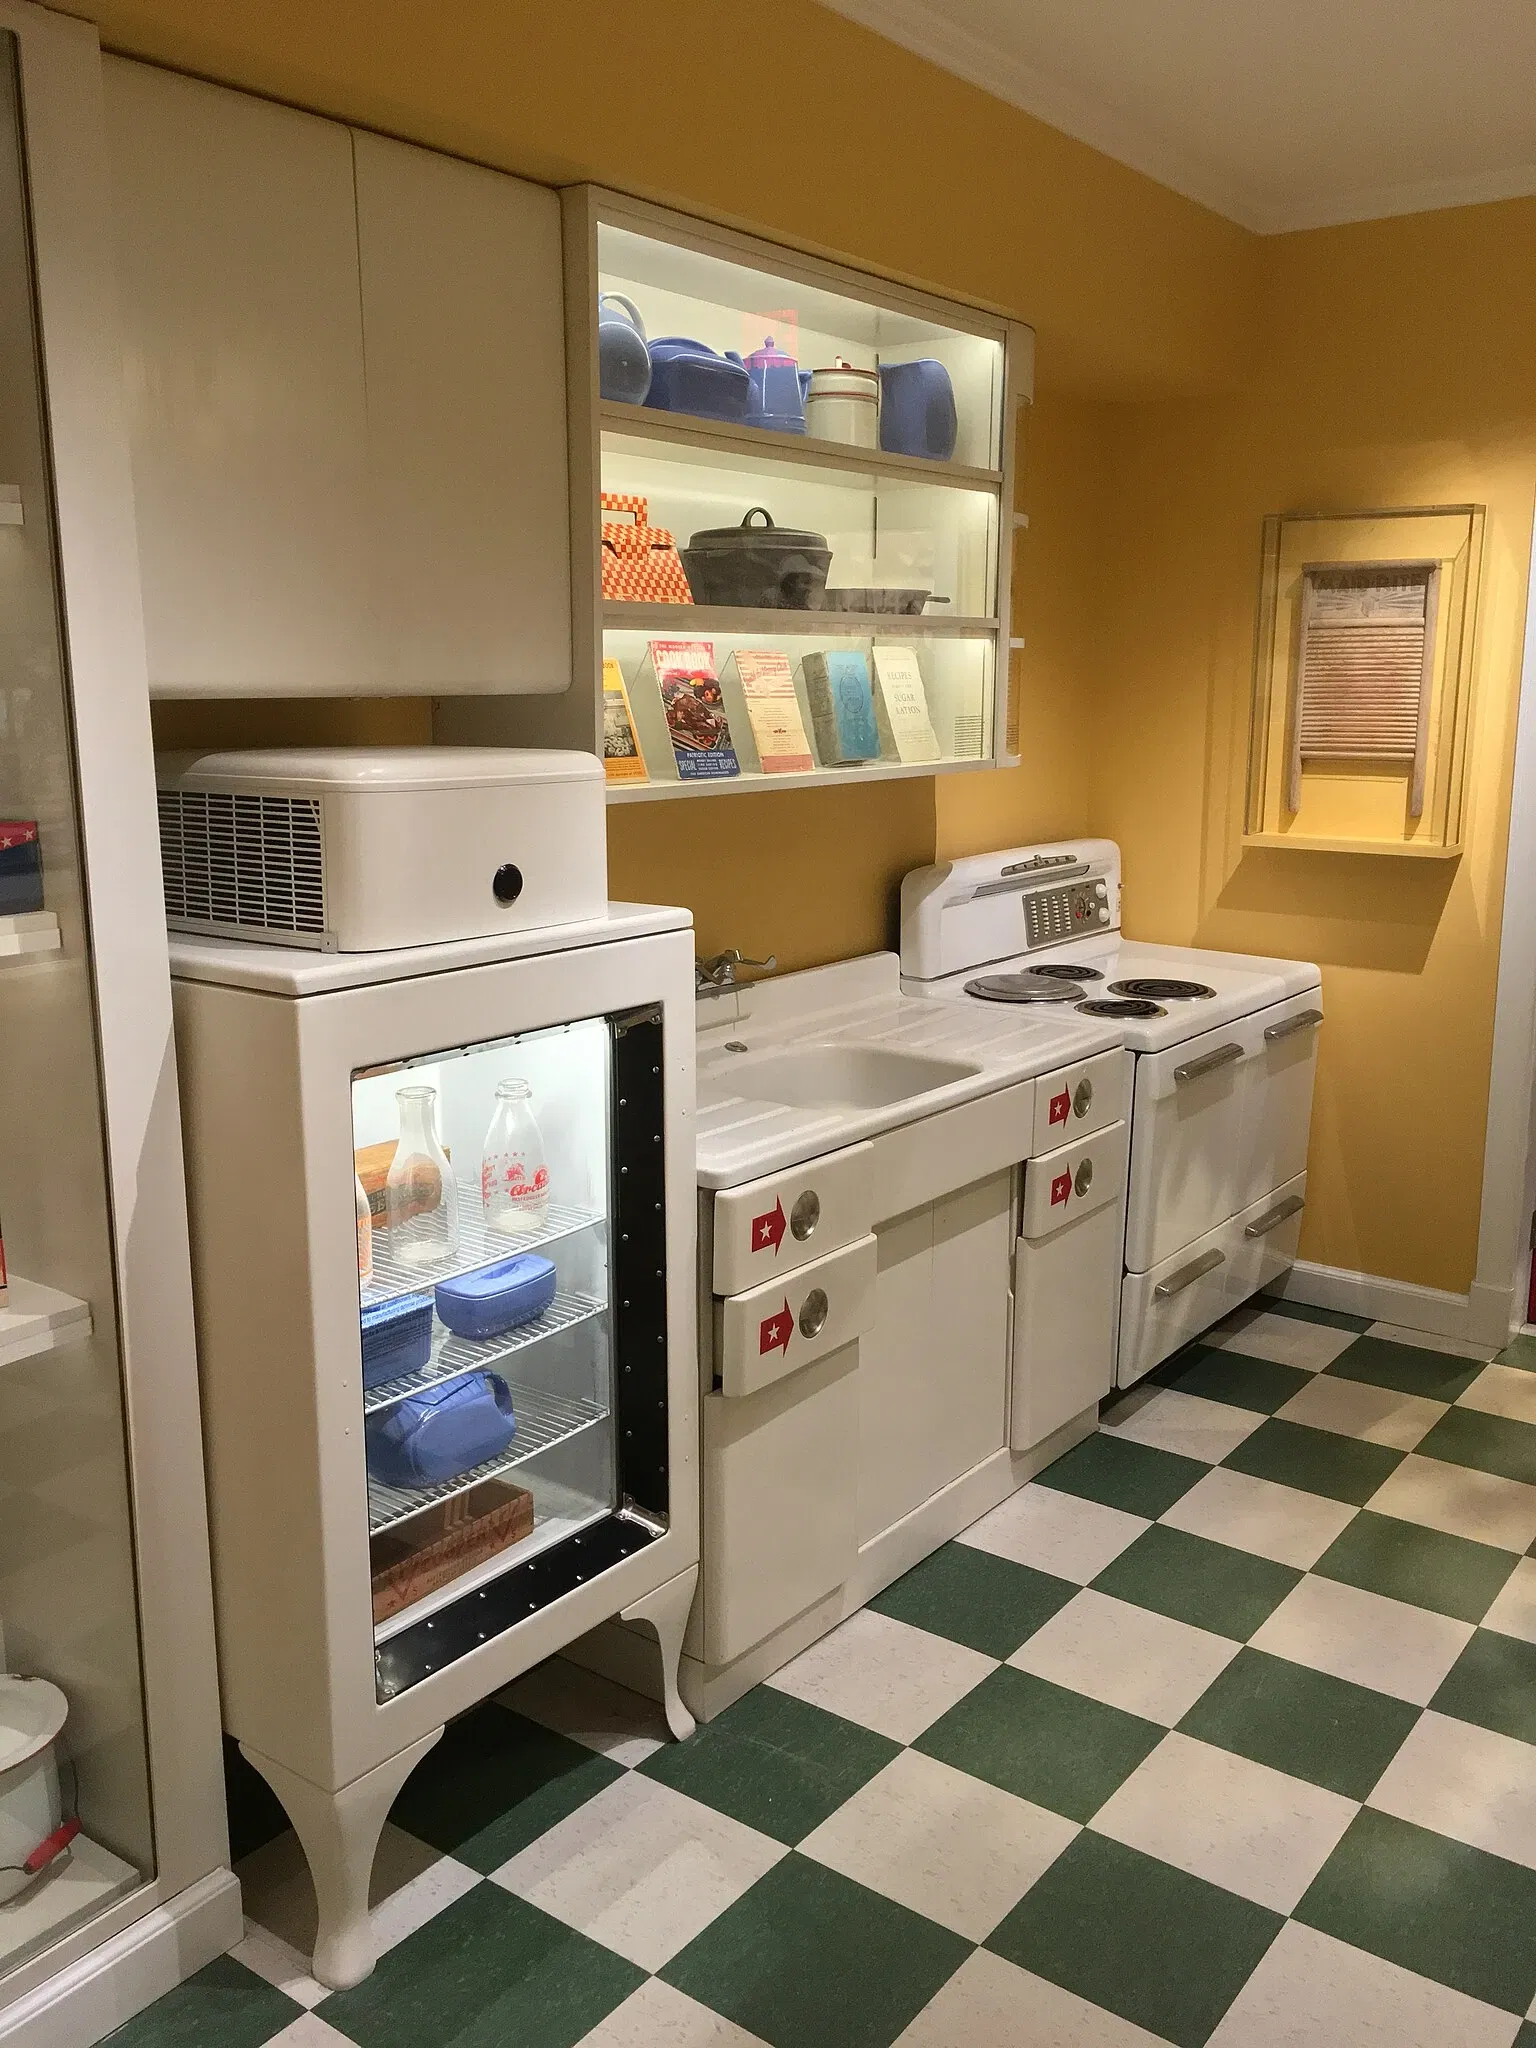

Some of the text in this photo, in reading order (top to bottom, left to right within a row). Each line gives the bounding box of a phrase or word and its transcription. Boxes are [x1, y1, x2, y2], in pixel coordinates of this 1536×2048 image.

[894, 694, 916, 702] SUGAR
[678, 760, 697, 771] SPECIAL
[718, 758, 737, 770] RECIPES
